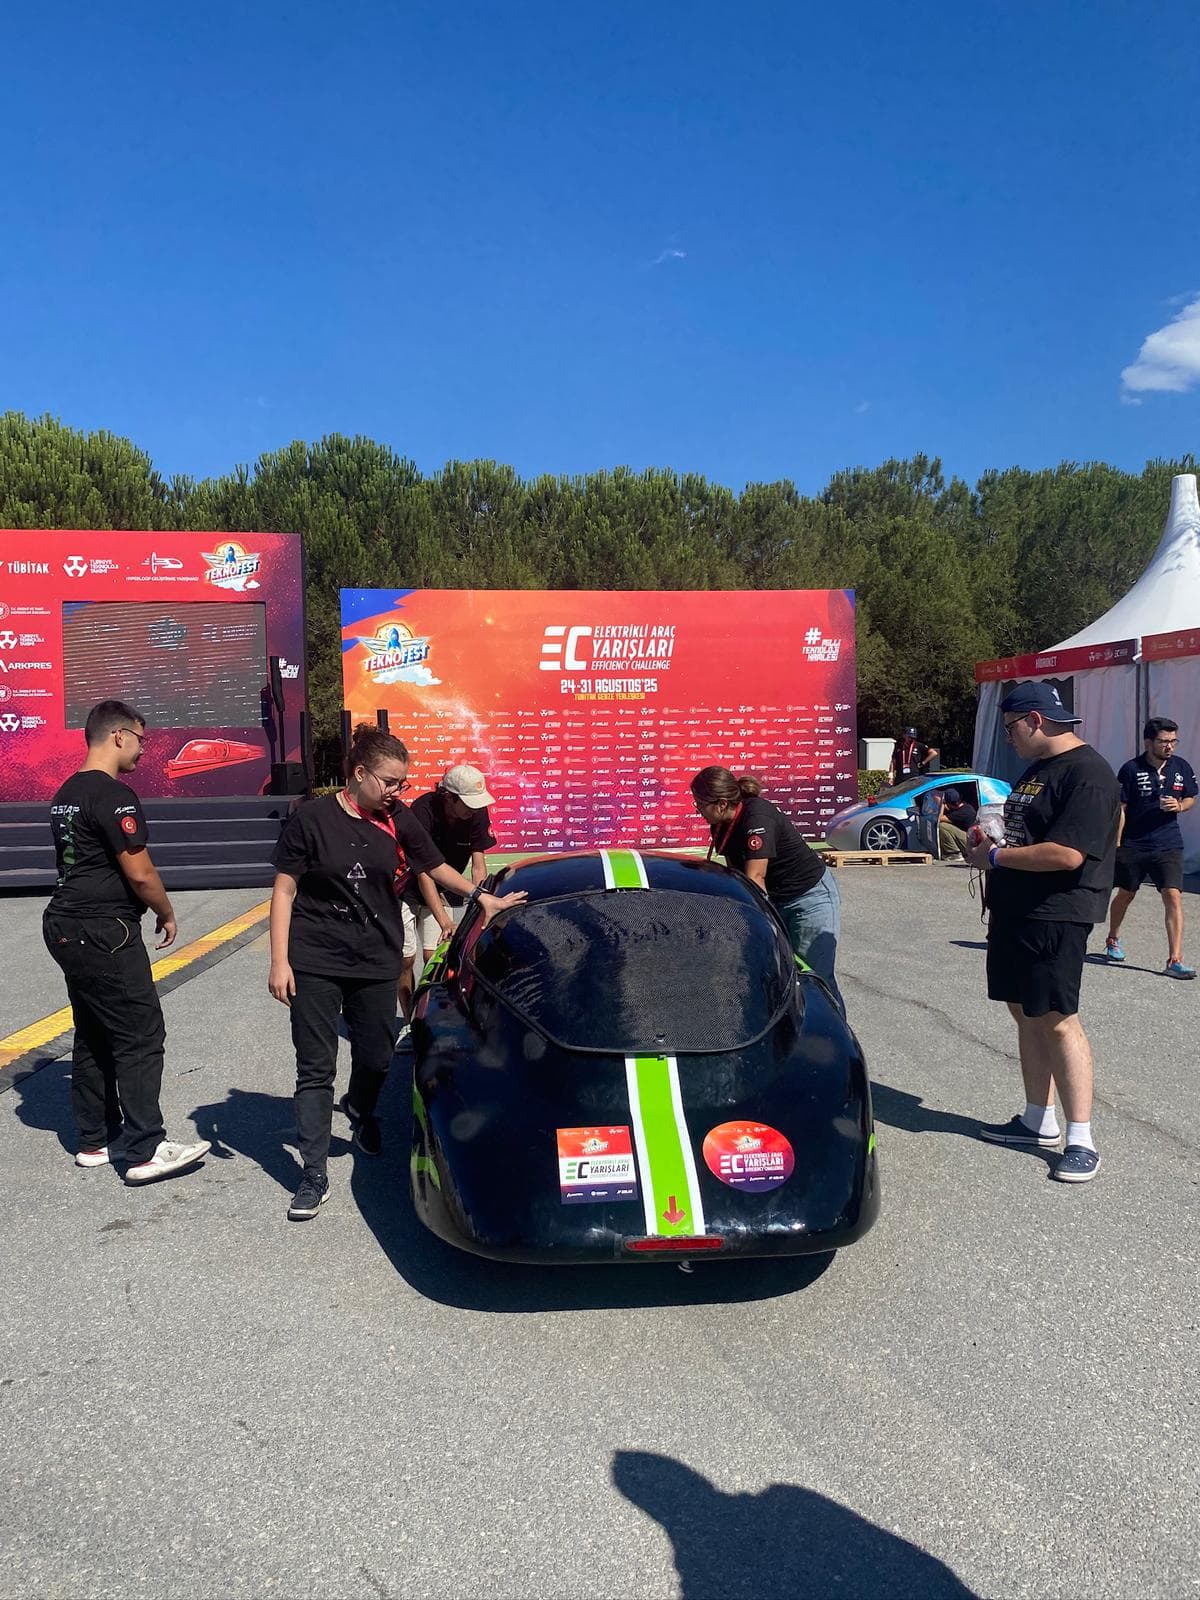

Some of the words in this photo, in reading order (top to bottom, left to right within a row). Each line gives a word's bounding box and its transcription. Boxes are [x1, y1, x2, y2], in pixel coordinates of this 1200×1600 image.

[7, 561, 49, 574] TÜBİTAK
[205, 560, 259, 580] TEKNOFEST
[594, 624, 648, 639] ELEKTRİKLİ
[650, 625, 676, 639] ARAÇ
[591, 638, 675, 660] YARIŞLARI
[8, 662, 52, 670] ARKPRES
[364, 645, 430, 673] TEKNOFEST
[591, 660, 631, 671] EFFICIENCY
[631, 660, 671, 671] CHALLENGE
[560, 679, 592, 694] 24-31
